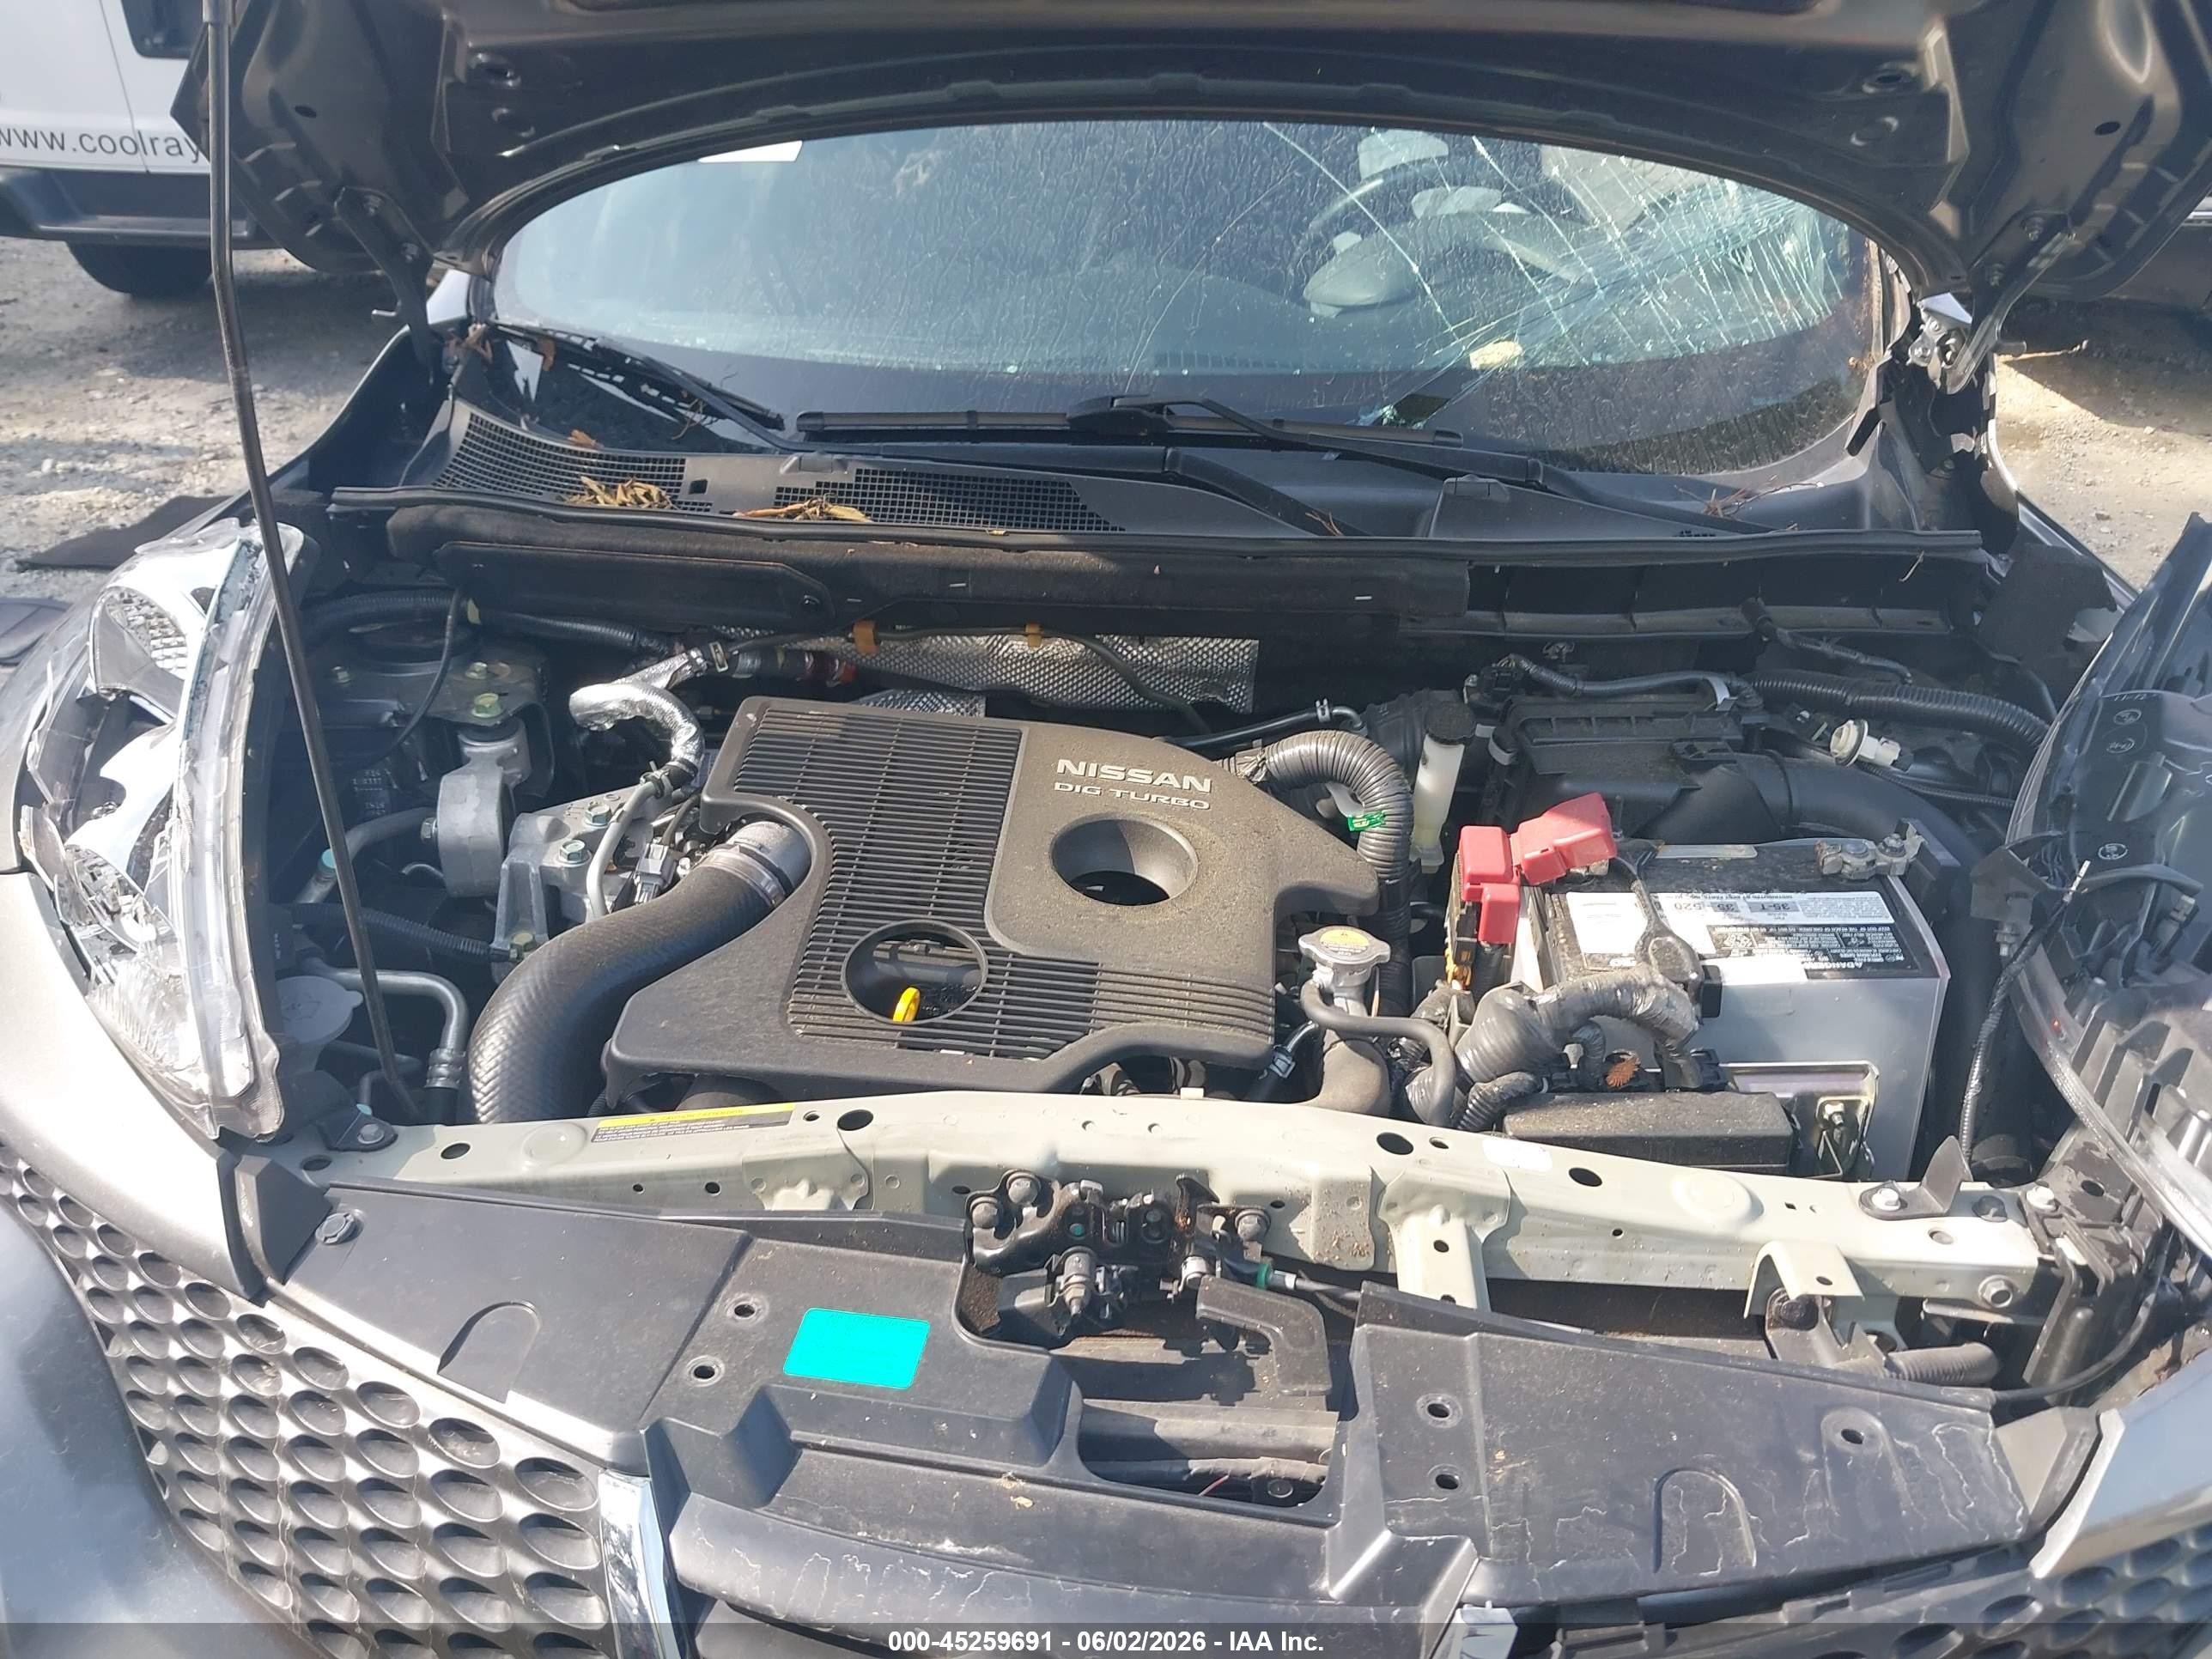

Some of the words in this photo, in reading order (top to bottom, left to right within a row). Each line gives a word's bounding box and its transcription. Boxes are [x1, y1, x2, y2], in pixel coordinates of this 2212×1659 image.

[1056, 759, 1212, 793] NISSAN
[1054, 782, 1102, 795] DIG
[1109, 788, 1211, 810] TURBO
